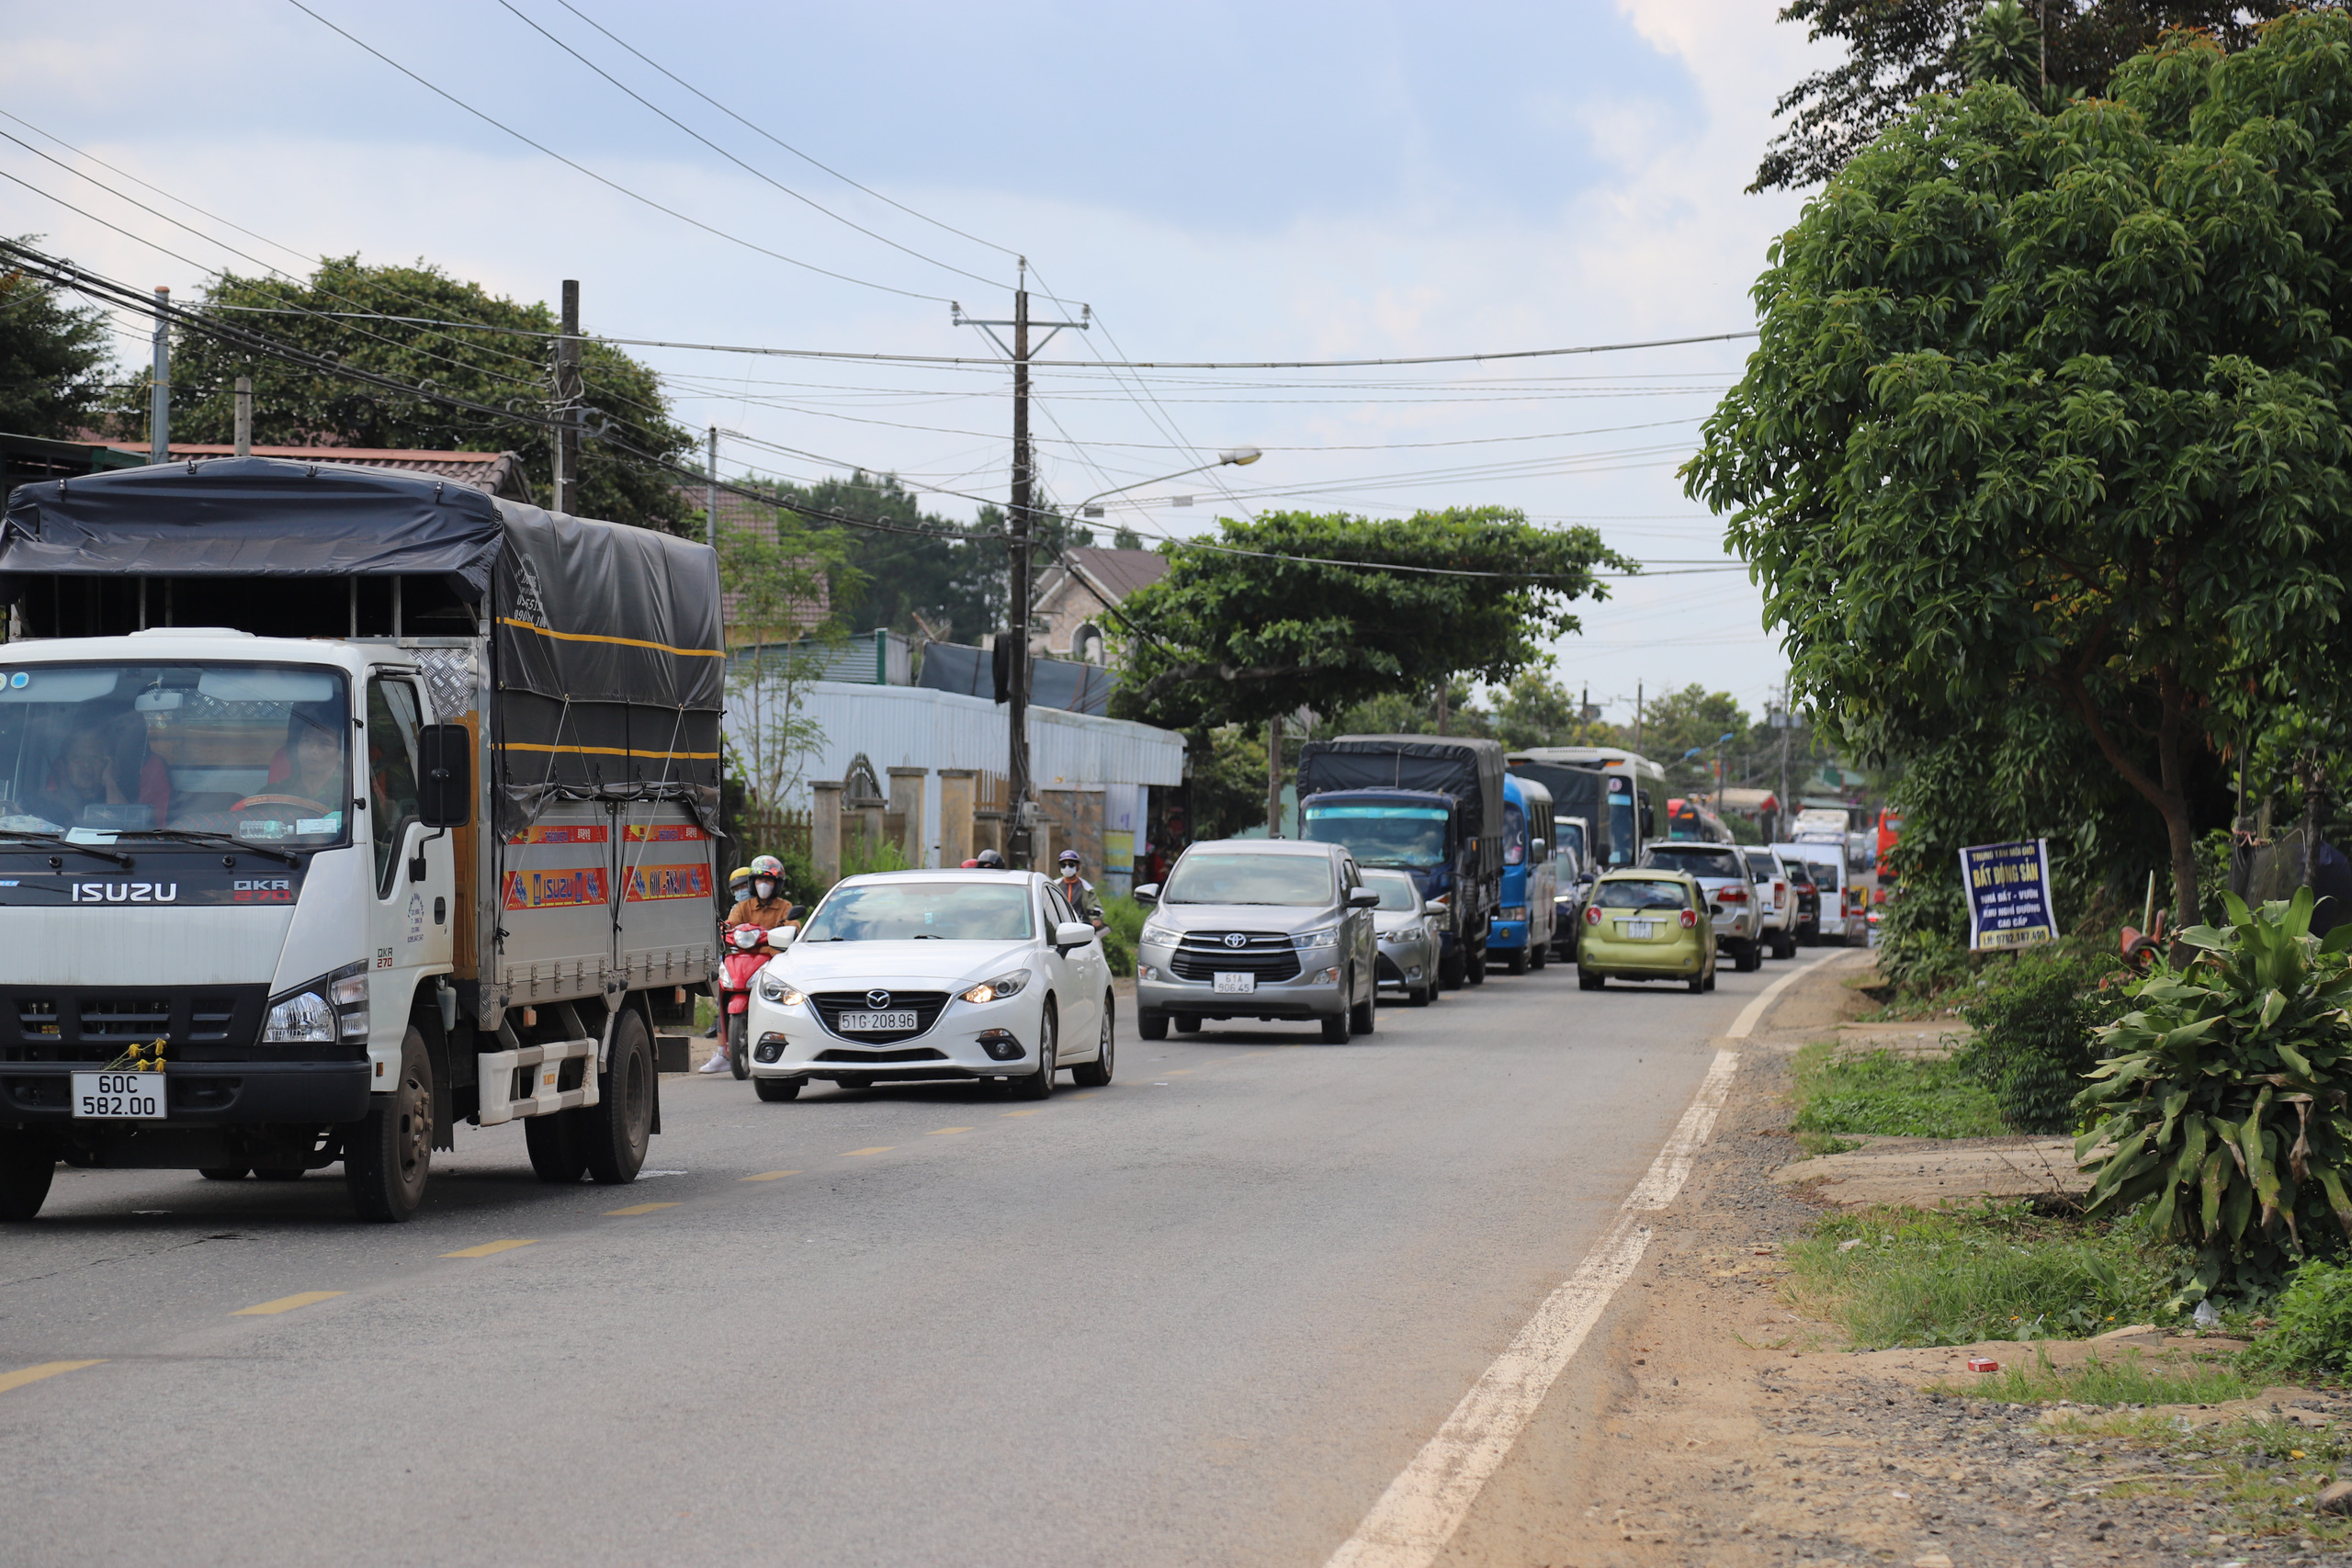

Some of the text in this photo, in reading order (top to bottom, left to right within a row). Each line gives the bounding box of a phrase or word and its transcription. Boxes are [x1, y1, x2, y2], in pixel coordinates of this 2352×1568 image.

[1973, 857, 2039, 888] BẤT ĐỘNG SẢN
[233, 880, 289, 890] QKR
[544, 877, 573, 899] ISUZU
[73, 883, 176, 902] ISUZU
[233, 891, 290, 901] 270
[378, 947, 393, 957] QKR
[377, 957, 392, 968] 270
[1226, 974, 1242, 983] 61A
[1218, 983, 1250, 992] 906.45
[842, 1013, 914, 1029] 51G-208.96
[98, 1075, 138, 1094] 60C
[83, 1096, 155, 1115] 582.00
